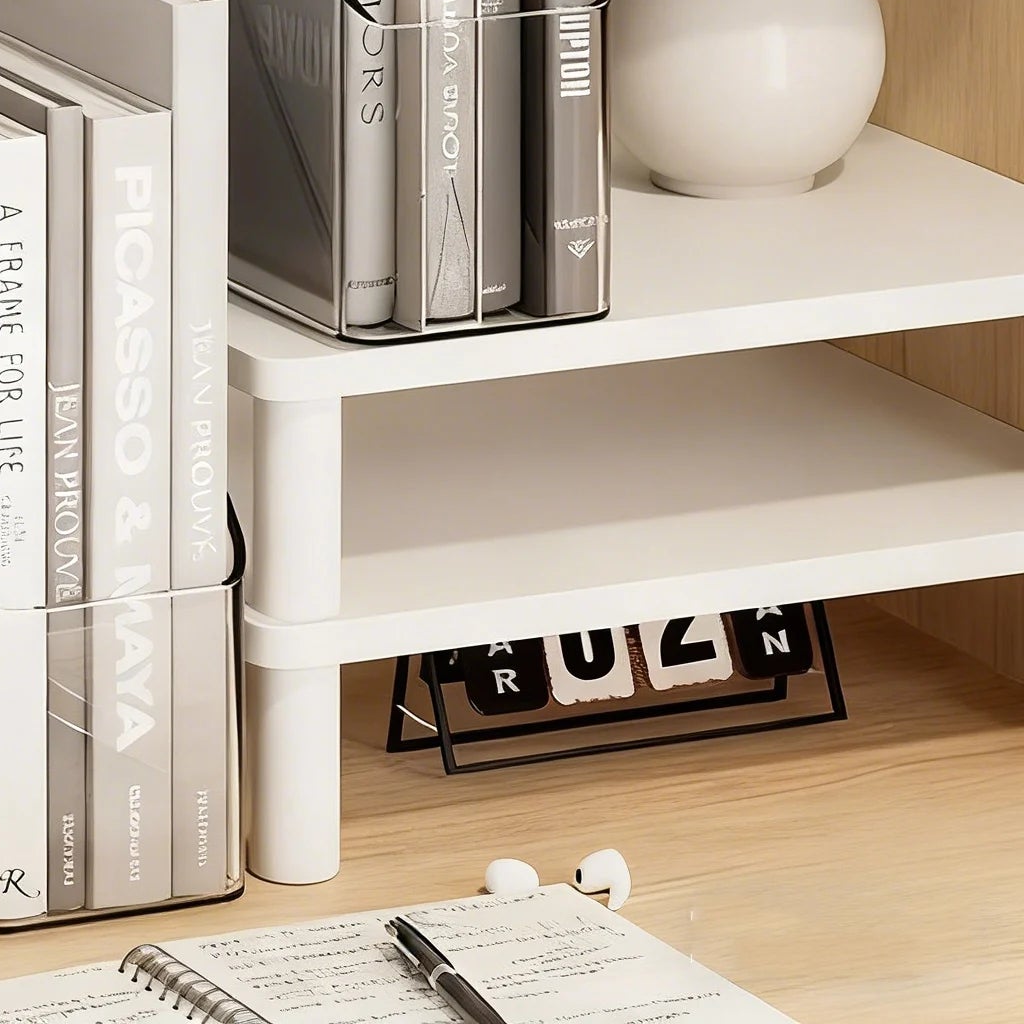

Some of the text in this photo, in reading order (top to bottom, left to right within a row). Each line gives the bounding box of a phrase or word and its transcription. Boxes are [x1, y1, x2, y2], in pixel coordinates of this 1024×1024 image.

[48, 382, 80, 459] JEAN
[114, 165, 157, 753] PICASSO & MAYA
